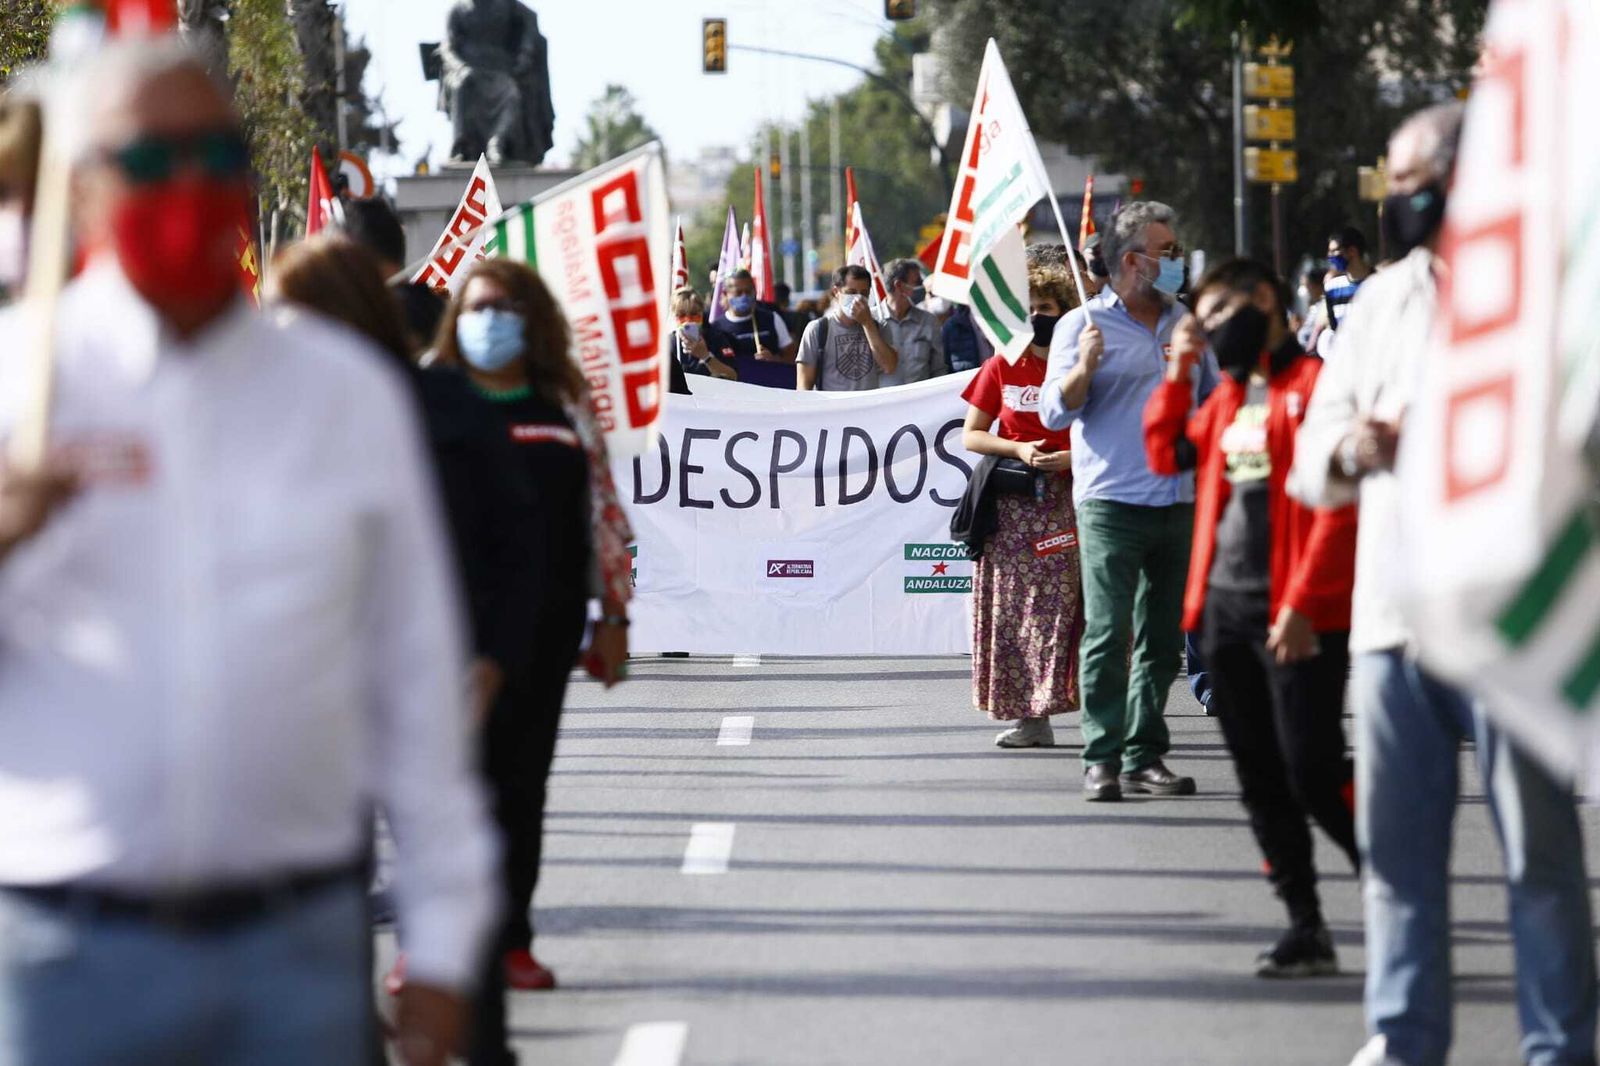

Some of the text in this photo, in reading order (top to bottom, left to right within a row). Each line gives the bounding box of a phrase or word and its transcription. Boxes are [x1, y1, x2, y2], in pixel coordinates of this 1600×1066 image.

[591, 170, 660, 429] CCOO
[633, 418, 968, 509] DESPIDOS
[906, 579, 972, 589] ANDALUZA
